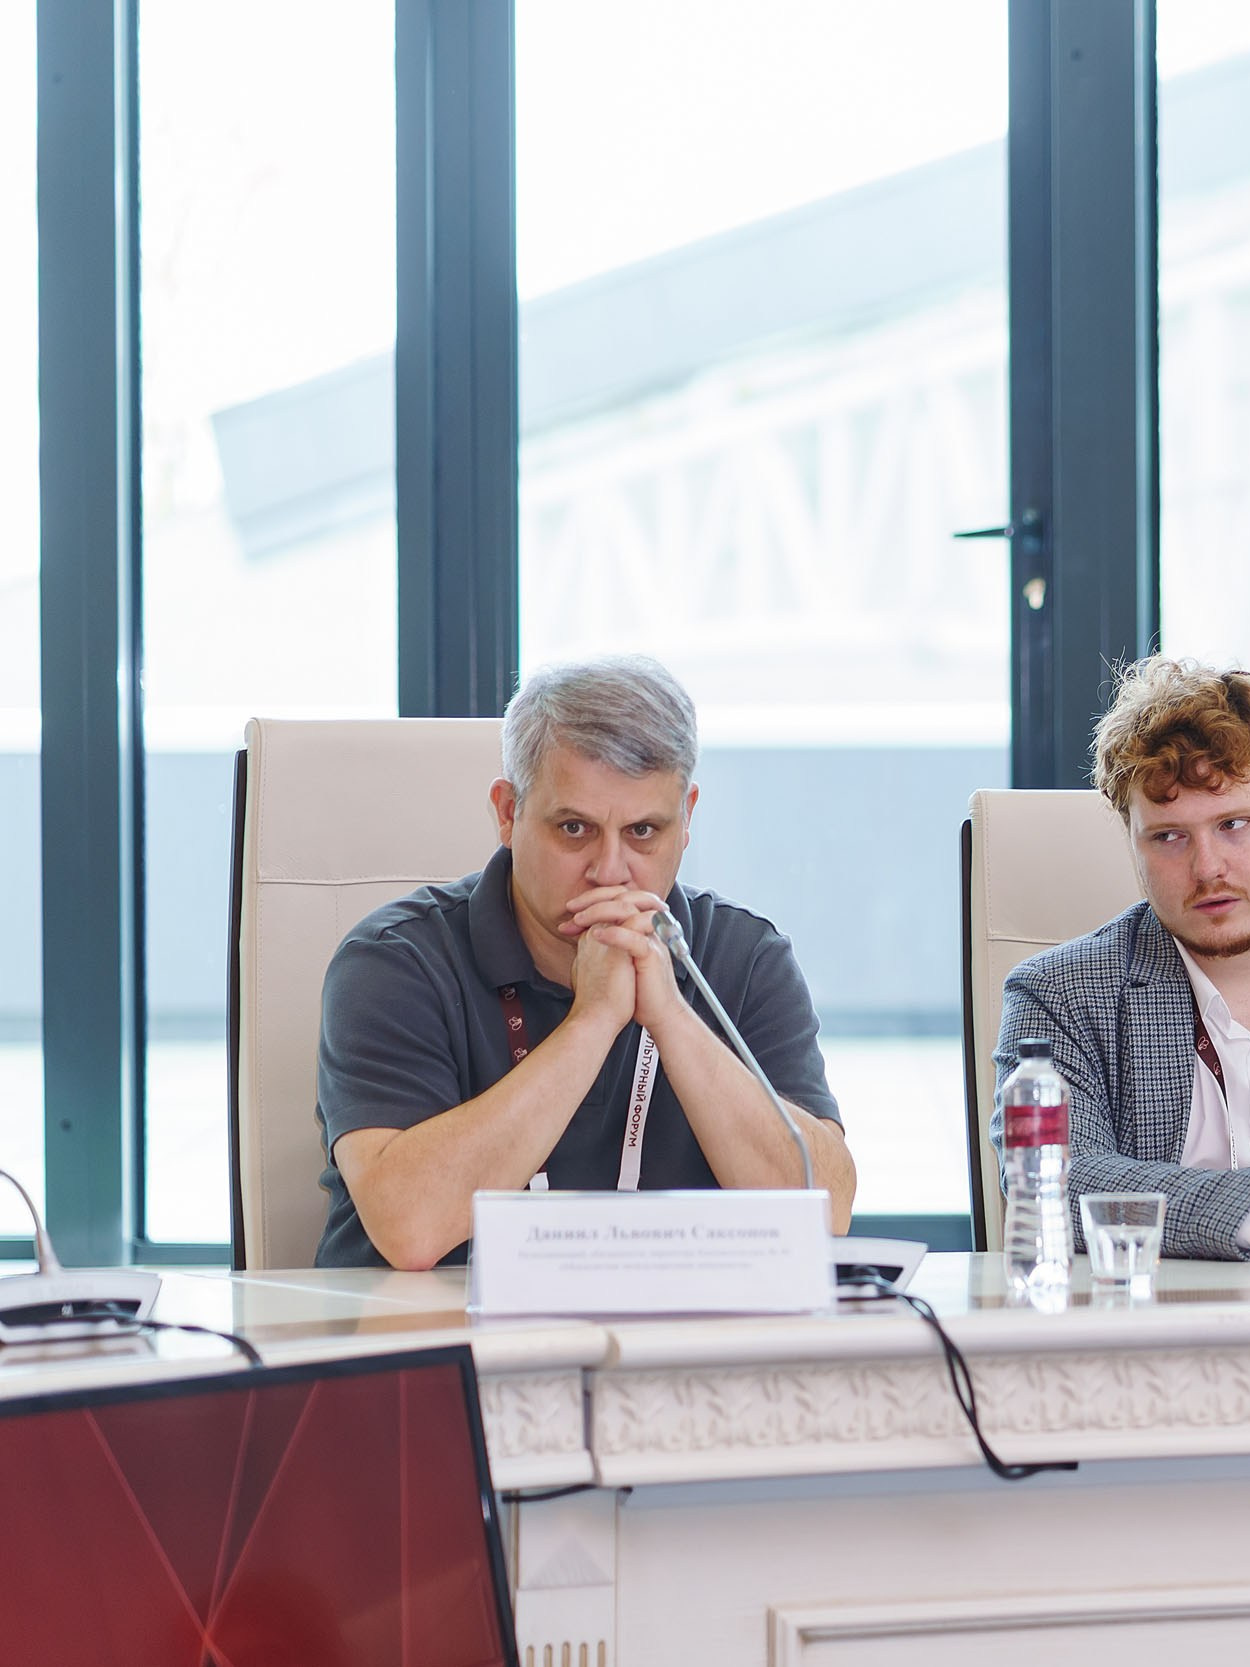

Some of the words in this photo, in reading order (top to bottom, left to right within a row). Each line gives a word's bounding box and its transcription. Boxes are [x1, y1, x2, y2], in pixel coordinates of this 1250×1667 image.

[628, 1105, 642, 1147] ФОРУМ
[526, 1223, 598, 1242] Даниил
[603, 1223, 686, 1240] Львович
